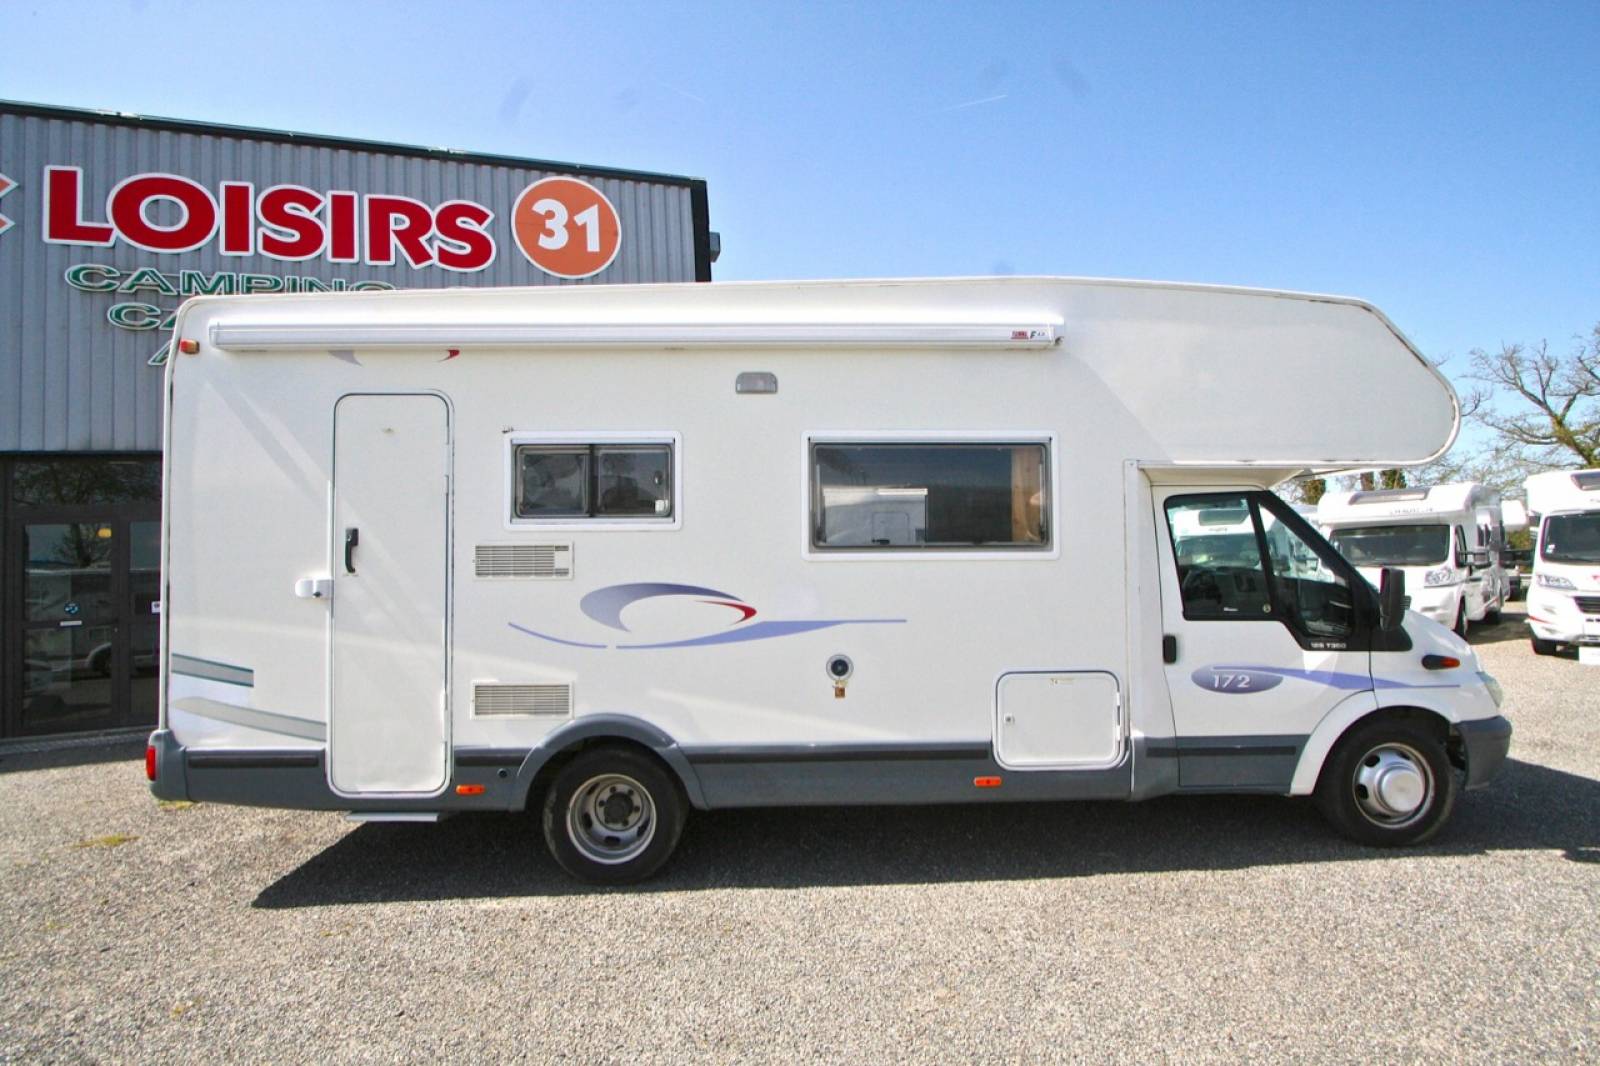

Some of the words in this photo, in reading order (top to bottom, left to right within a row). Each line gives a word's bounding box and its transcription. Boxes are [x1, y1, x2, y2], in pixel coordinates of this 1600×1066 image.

[43, 164, 497, 272] LOISIRS
[533, 197, 602, 253] 31
[1214, 674, 1250, 689] 172
